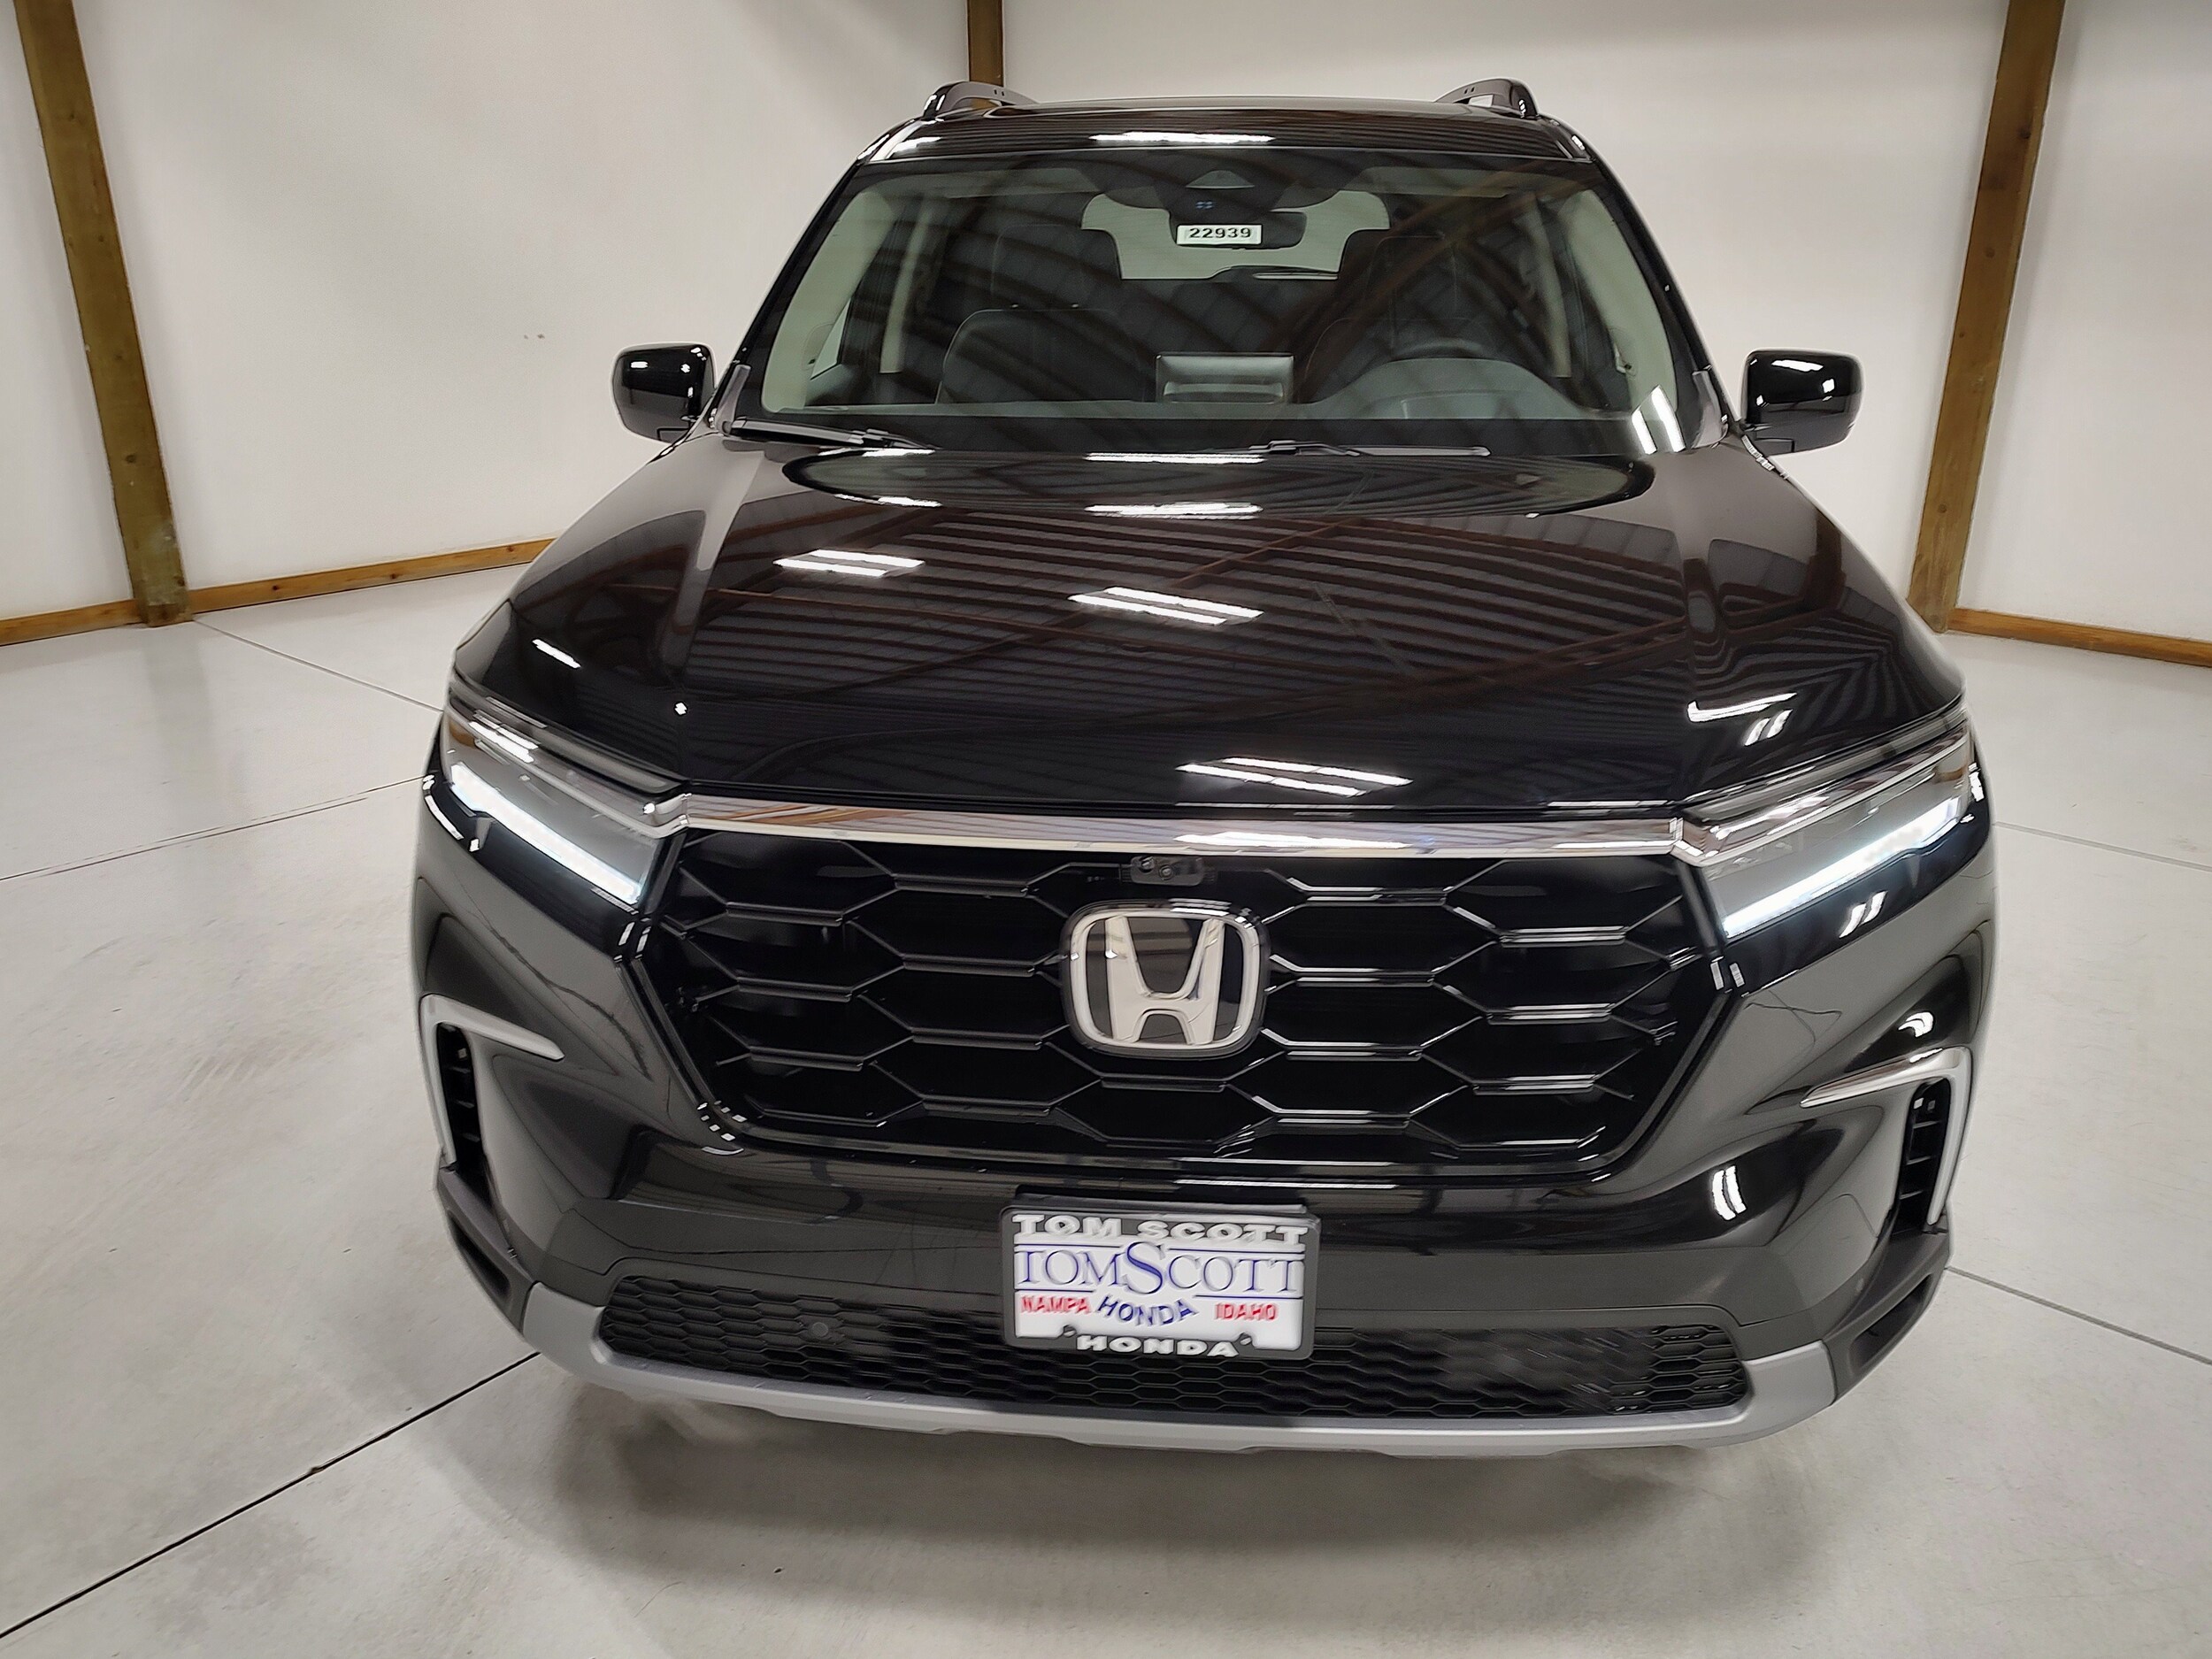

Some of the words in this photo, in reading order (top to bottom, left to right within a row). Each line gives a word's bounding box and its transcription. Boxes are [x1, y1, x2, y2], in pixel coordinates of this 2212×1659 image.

[1189, 227, 1251, 239] 22939
[1012, 1214, 1122, 1238] TOM
[1137, 1220, 1309, 1246] SCOTT
[1019, 1295, 1092, 1314] NAMPA
[1097, 1294, 1199, 1326] HONDA
[1215, 1302, 1279, 1321] IDAHO
[1076, 1335, 1239, 1357] HONDA
